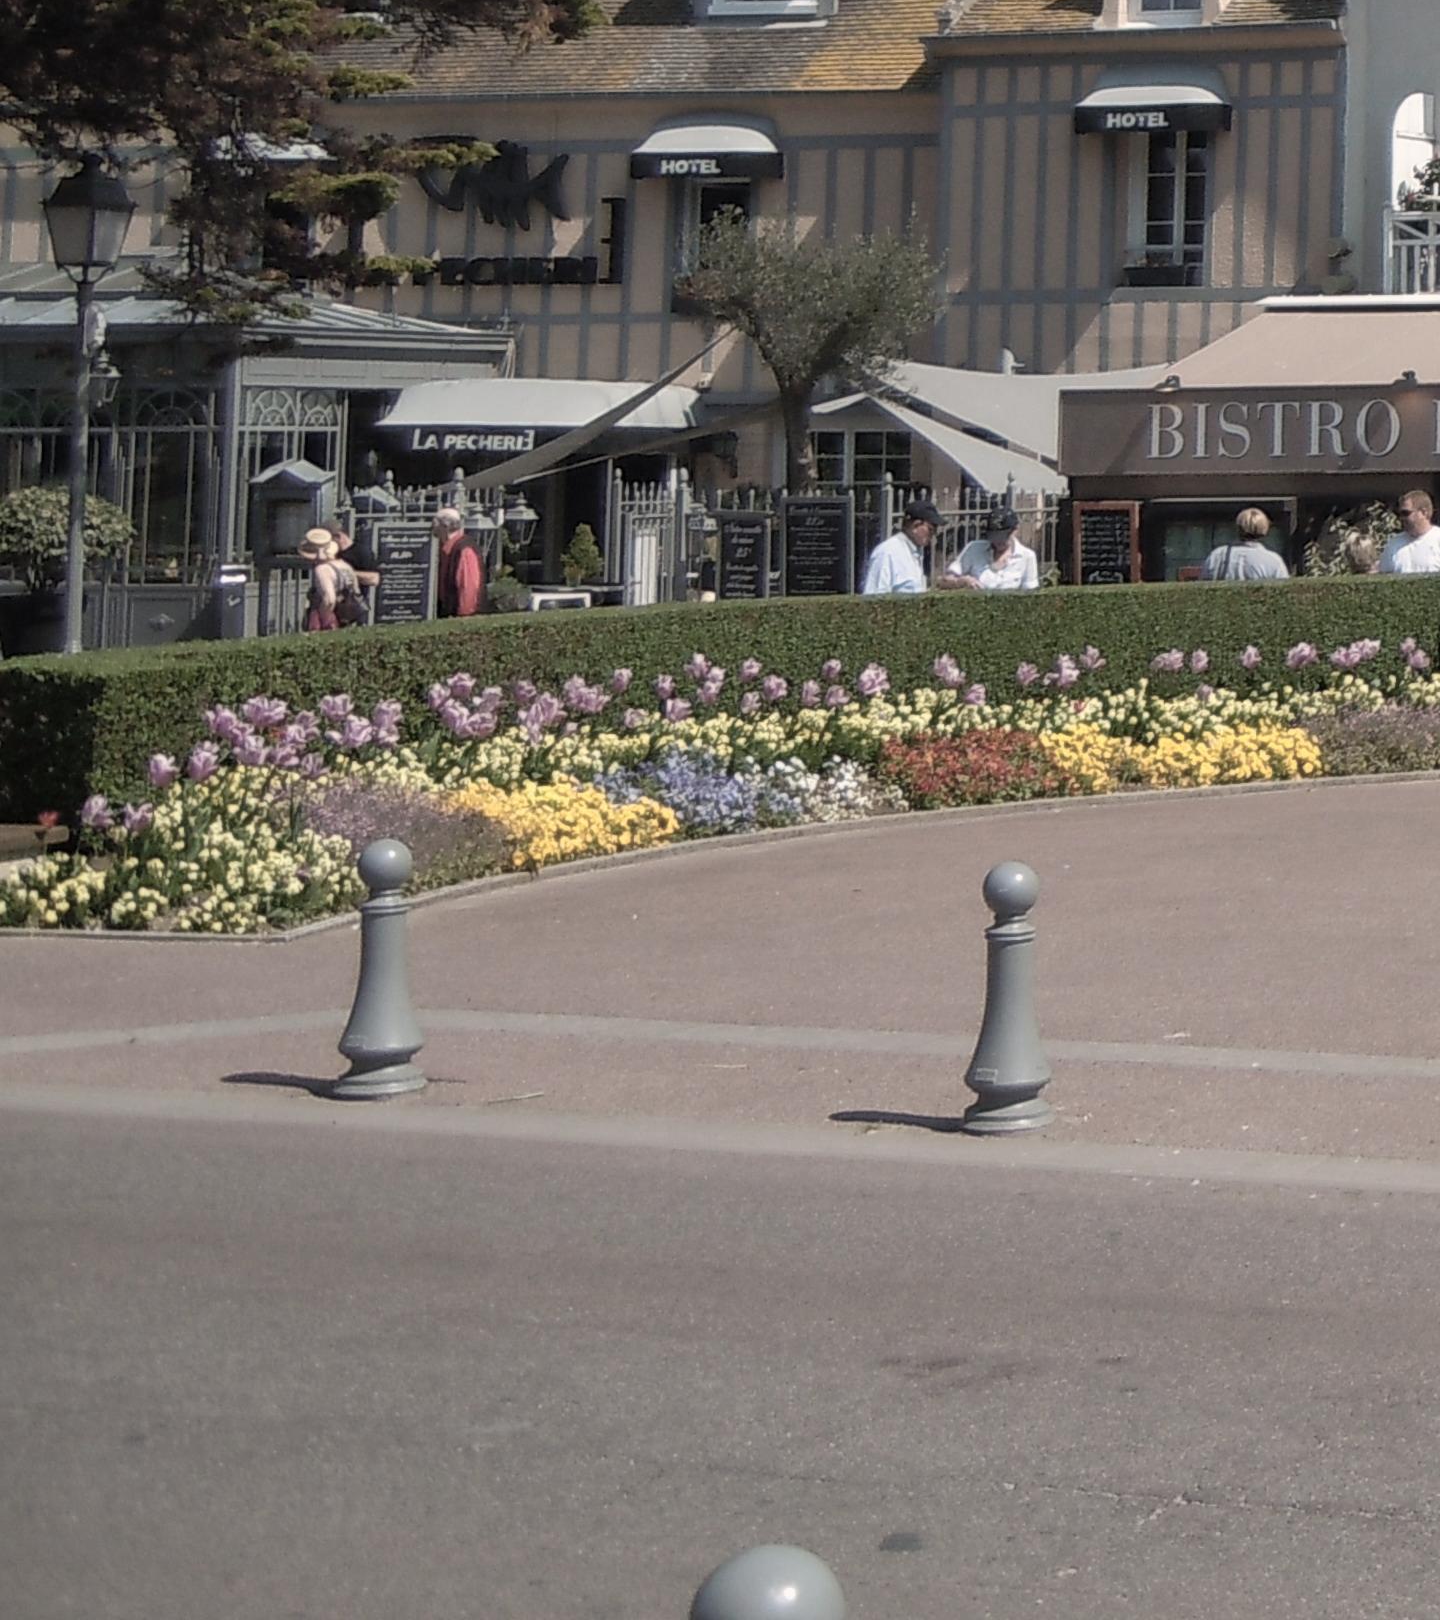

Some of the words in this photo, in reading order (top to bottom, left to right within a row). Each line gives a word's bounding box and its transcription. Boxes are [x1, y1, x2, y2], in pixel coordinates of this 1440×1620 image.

[1106, 111, 1169, 128] HOTEL
[660, 159, 722, 175] HOTEL
[1146, 398, 1401, 459] BISTRO
[412, 428, 439, 450] LA
[443, 429, 536, 451] PECHERIE
